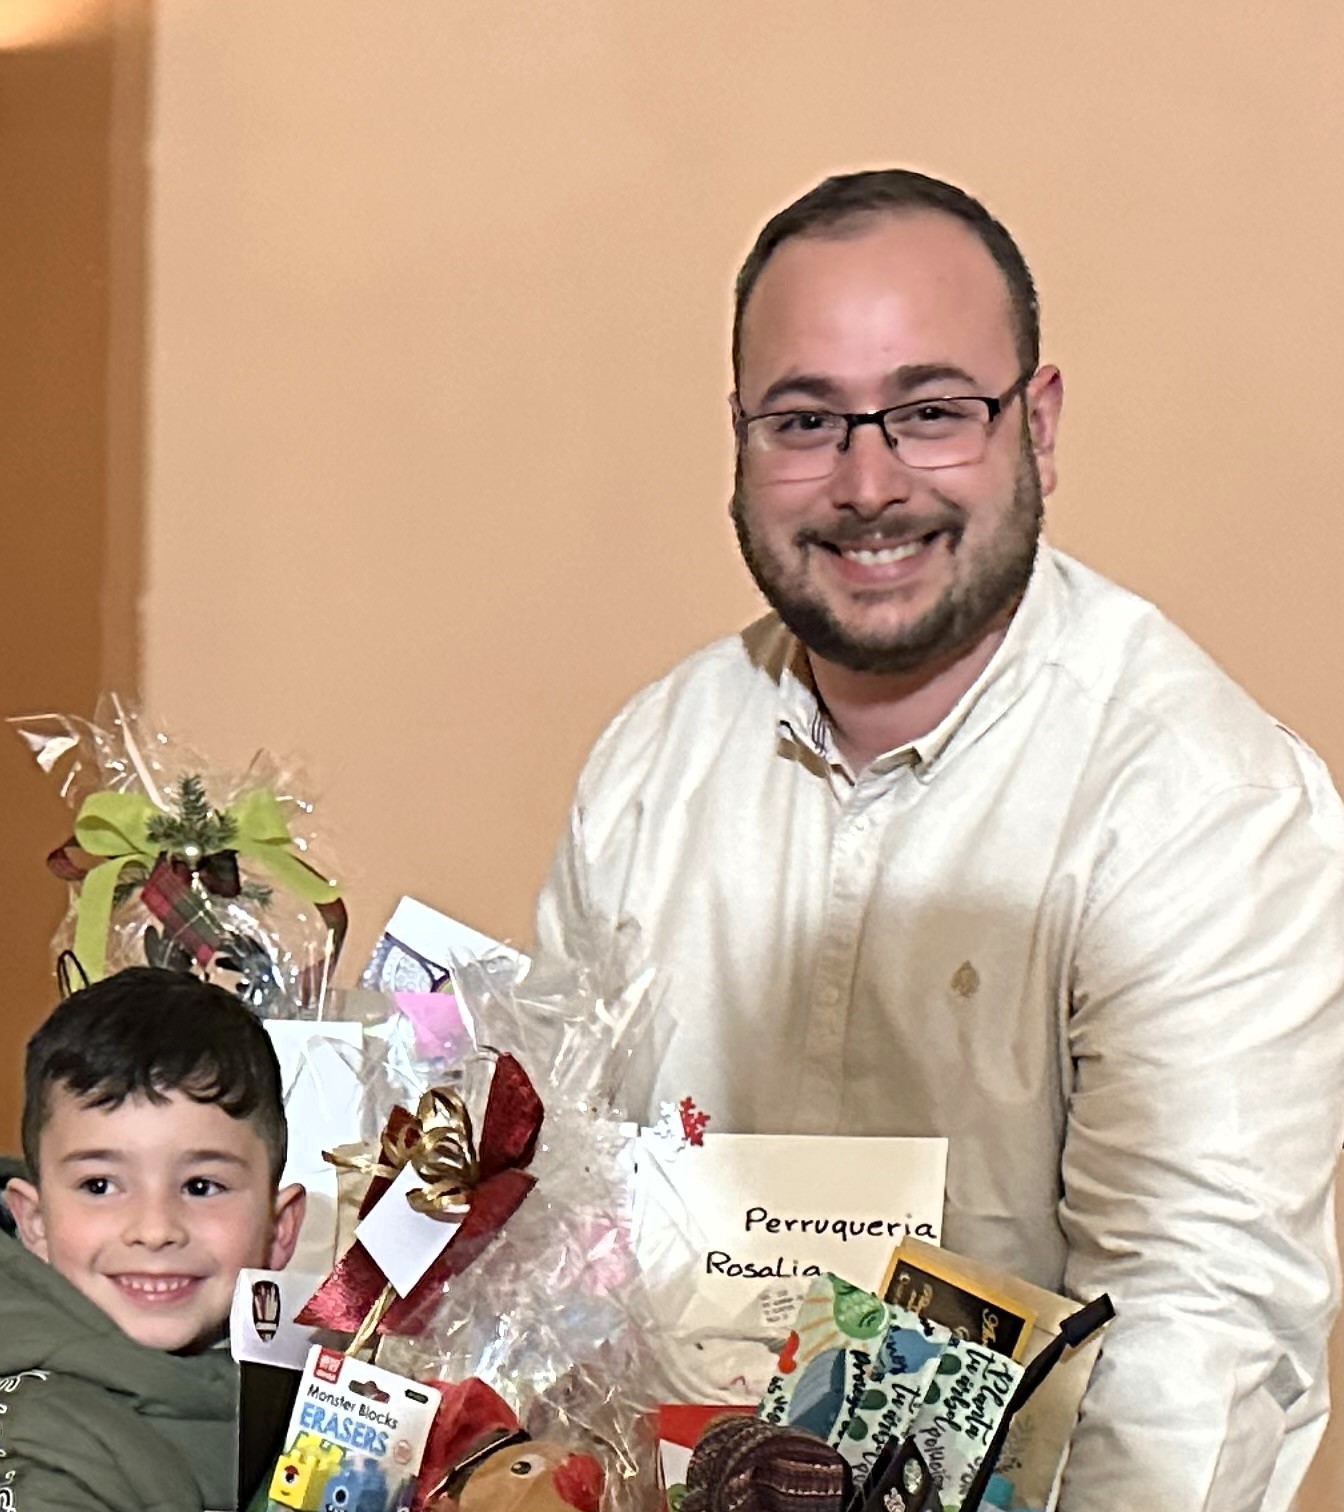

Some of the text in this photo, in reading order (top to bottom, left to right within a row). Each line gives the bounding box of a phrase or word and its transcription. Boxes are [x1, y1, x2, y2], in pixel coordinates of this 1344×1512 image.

[745, 1206, 938, 1242] Perruqueria
[706, 1250, 821, 1278] Rosalia
[306, 1383, 399, 1430] Monster Blocks
[299, 1401, 390, 1457] ERASERS
